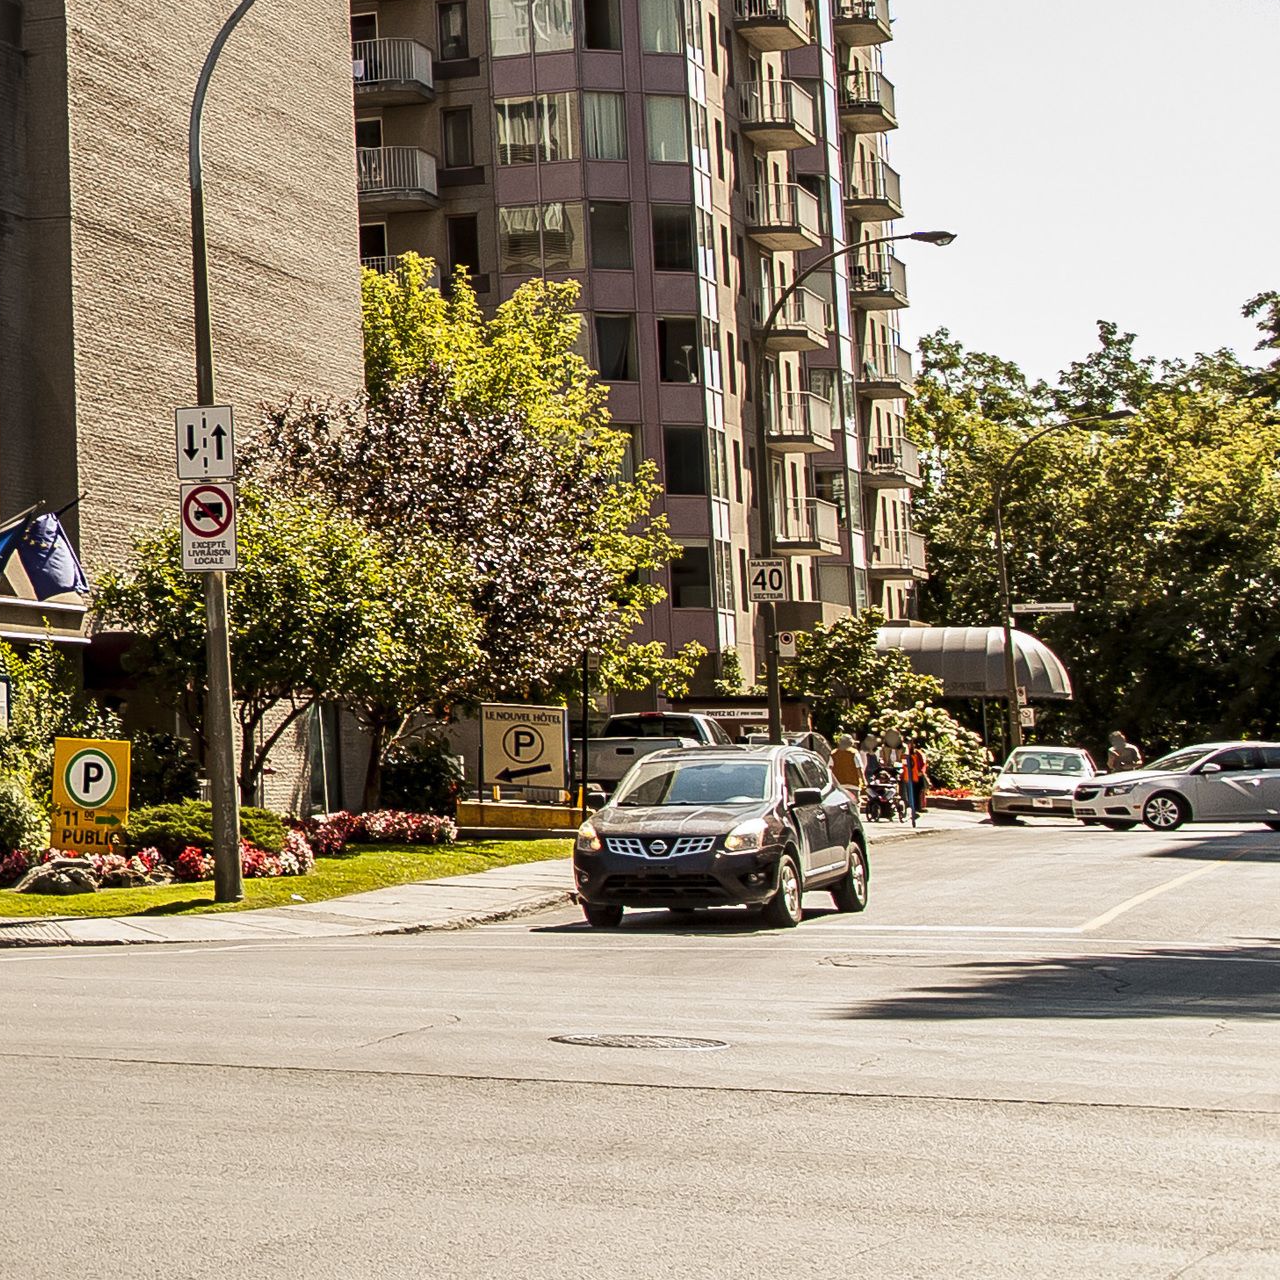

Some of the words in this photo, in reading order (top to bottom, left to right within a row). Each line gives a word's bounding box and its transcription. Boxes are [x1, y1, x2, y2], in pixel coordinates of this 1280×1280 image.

[188, 549, 231, 557] LIVRAISON
[194, 556, 225, 565] LOCALE
[752, 568, 783, 591] 40
[753, 592, 784, 600] SECTEUR
[485, 711, 496, 720] LE
[496, 711, 530, 722] NOUVEL
[531, 712, 561, 723] HÔTEL
[514, 730, 535, 757] P
[83, 762, 104, 794] P
